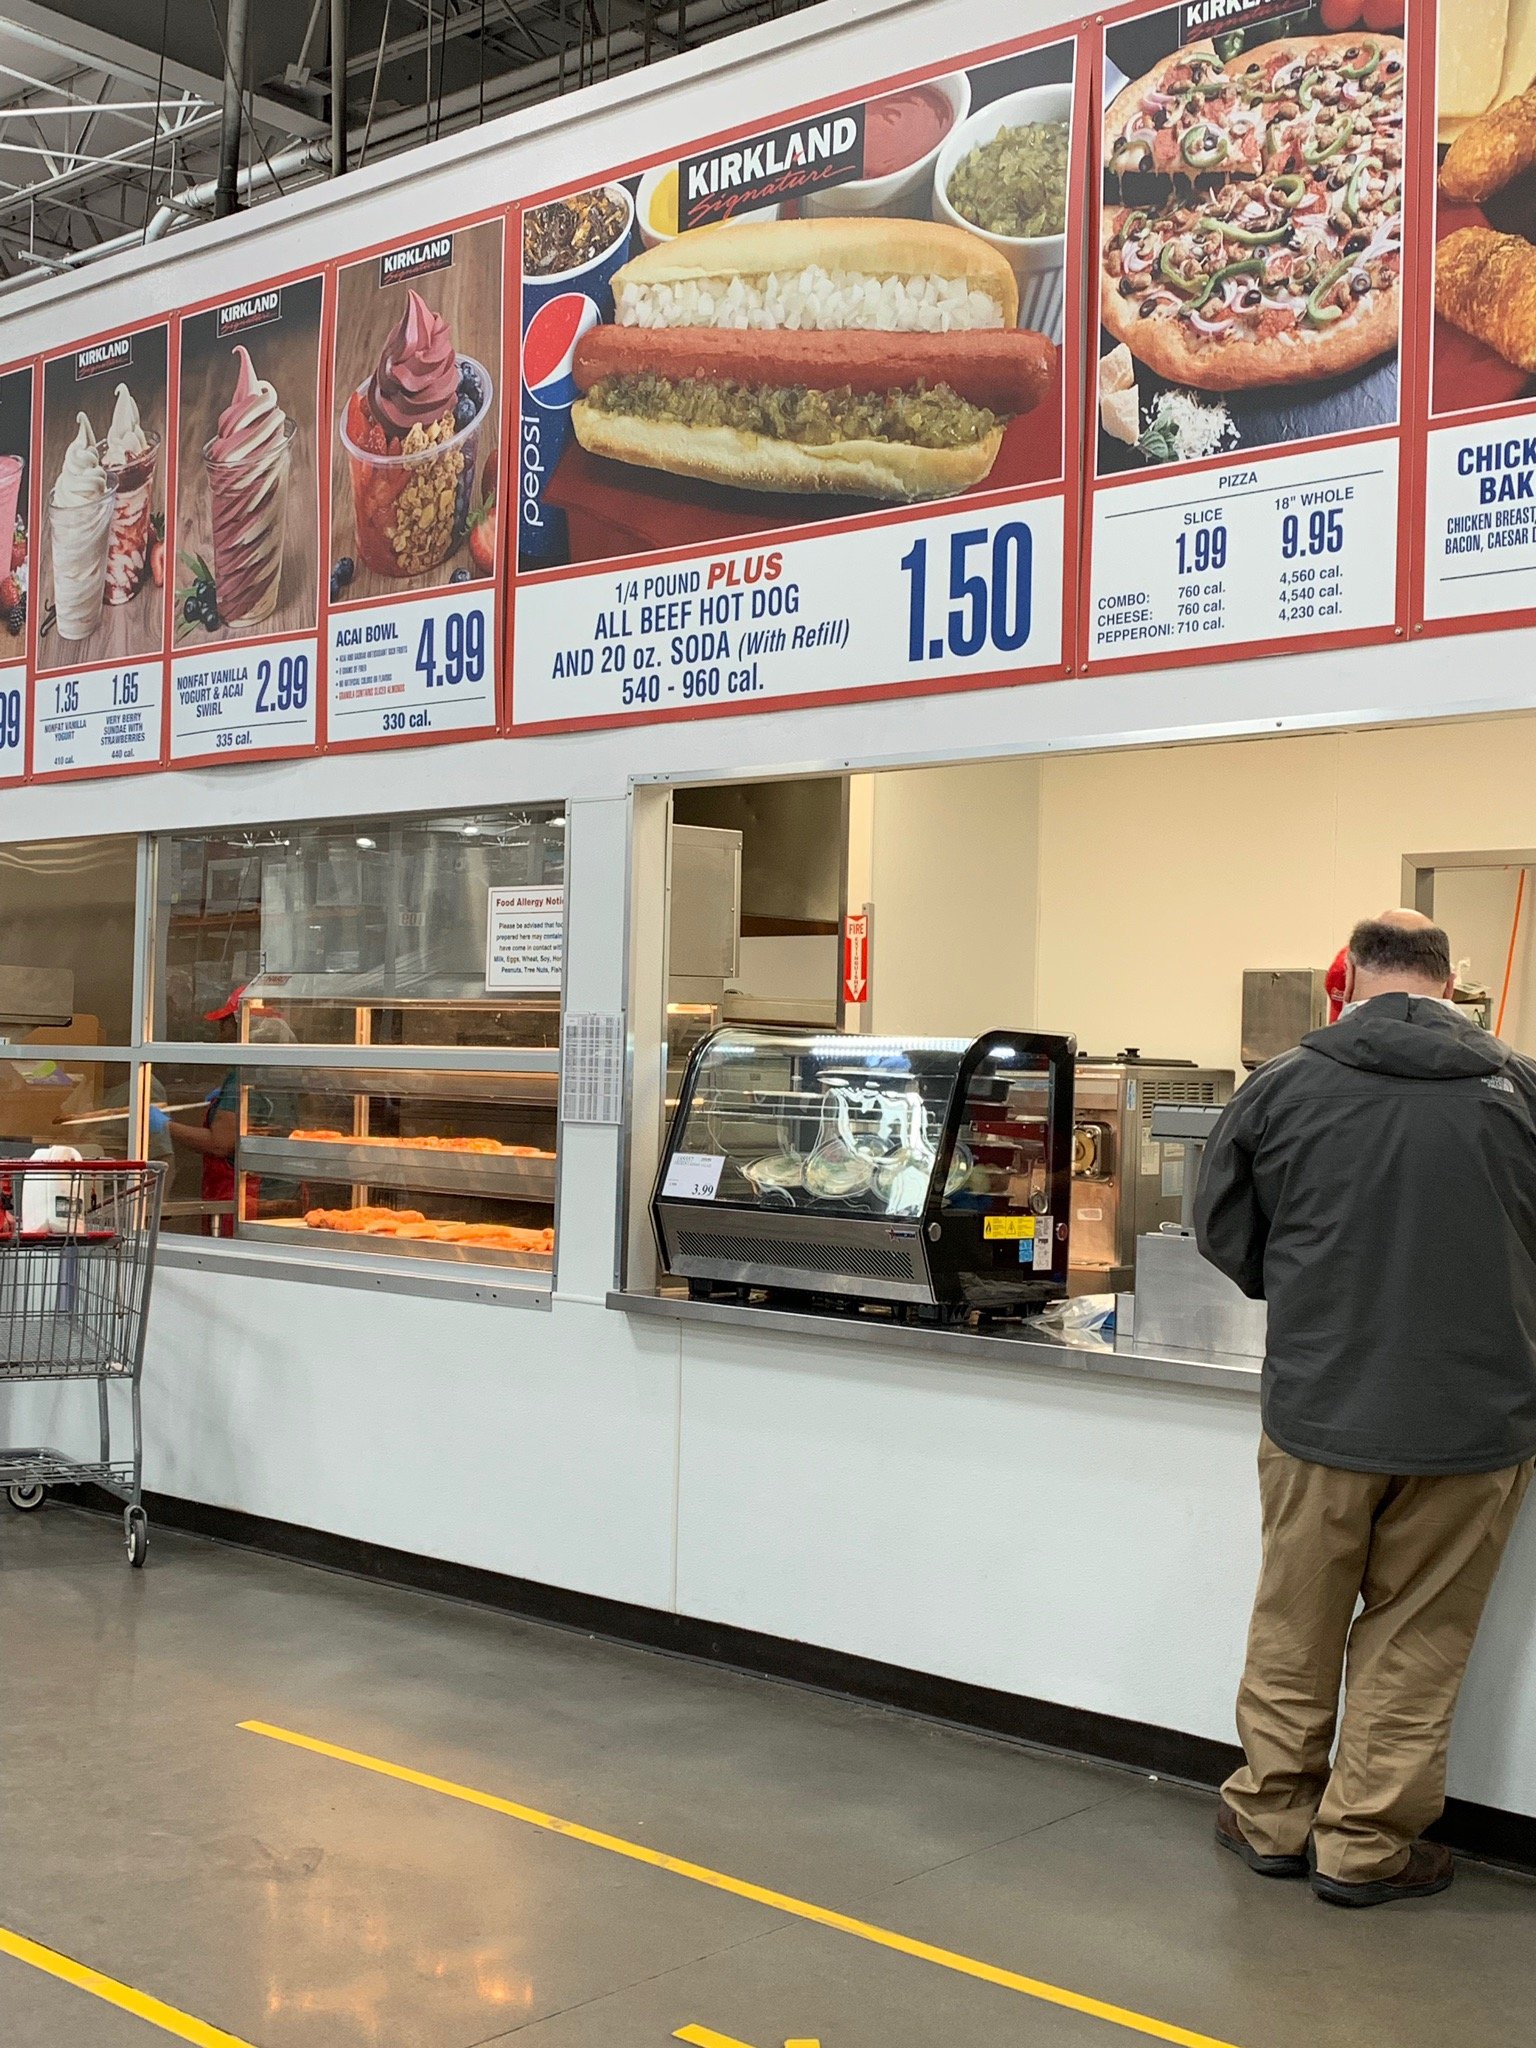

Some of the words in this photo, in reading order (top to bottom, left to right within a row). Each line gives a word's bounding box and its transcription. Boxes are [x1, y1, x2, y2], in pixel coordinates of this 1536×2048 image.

[688, 117, 857, 200] KIRKLAND
[687, 164, 856, 227] Signature
[384, 239, 450, 273] KIRKLAND
[221, 293, 278, 324] KIRKLAND
[79, 340, 129, 368] KIRKLAND
[521, 414, 545, 527] pepsi
[1219, 472, 1258, 489] PIZZA
[1480, 470, 1534, 505] BAK
[1275, 496, 1297, 511] 18"
[1300, 487, 1354, 507] WHOLE
[1183, 508, 1223, 526] SLICE
[1447, 512, 1492, 535] CHICKEN
[1282, 508, 1344, 559] 9.95
[1445, 534, 1484, 555] BACON,
[1488, 527, 1529, 549] CAESAR
[1175, 526, 1227, 575] 1.99
[615, 580, 638, 605] 1/4
[644, 571, 700, 600] POUND
[707, 552, 783, 590] PLUS
[1279, 568, 1315, 586] 4,560
[1319, 565, 1343, 582] cal.
[901, 521, 1032, 662] 1.50
[1178, 584, 1200, 599] 760
[1203, 581, 1226, 595] cal.
[1279, 586, 1315, 605] 4,540
[1318, 583, 1343, 599] cal.
[595, 610, 632, 640] ALL
[640, 600, 692, 635] BEEF
[700, 592, 744, 626] HOT
[752, 583, 799, 619] DOG
[1098, 592, 1150, 611] COMBO:
[1178, 602, 1200, 617] 760
[1203, 599, 1225, 614] cal.
[1097, 610, 1153, 628] CHEESE:
[1278, 605, 1314, 624] 4,230
[1318, 602, 1342, 618] cal.
[336, 628, 362, 647] ACAI
[365, 622, 399, 643] BOWL
[1097, 625, 1174, 645] PEPPERONI:
[1177, 620, 1199, 634] 710
[1202, 617, 1225, 631] cal.
[415, 609, 485, 688] 4.99
[552, 649, 594, 679] AND
[601, 644, 625, 673] 20
[633, 647, 662, 669] oz.
[671, 630, 730, 665] SODA
[738, 628, 786, 661] (With
[792, 618, 850, 649] Refill)
[112, 672, 139, 706] 1.65
[177, 672, 209, 690] NONFAT
[211, 667, 248, 685] VANILLA
[255, 654, 308, 713] 2.99
[622, 674, 660, 705] 540
[668, 684, 675, 692] -
[683, 667, 720, 699] 960
[728, 662, 764, 693] cal.
[55, 681, 79, 714] 1.35
[179, 688, 211, 705] YOGURT
[213, 686, 220, 700] &
[222, 683, 243, 698] ACAI
[106, 715, 120, 725] VERY
[122, 712, 141, 723] BERRY
[196, 703, 223, 718] SWIRL
[383, 712, 406, 731] 330
[409, 709, 431, 728] cal.
[44, 722, 64, 734] NONFAT
[65, 720, 86, 731] VANILLA
[104, 725, 126, 735] SUNDAE
[128, 722, 143, 732] WITH
[101, 733, 145, 746] STRAWBERRIES
[216, 733, 233, 748] 335
[235, 731, 252, 746] cal.
[124, 748, 135, 758] cal.
[496, 898, 514, 907] Food
[517, 897, 543, 907] Allergy
[849, 923, 864, 935] FIRE
[691, 1184, 714, 1196] 3.99
